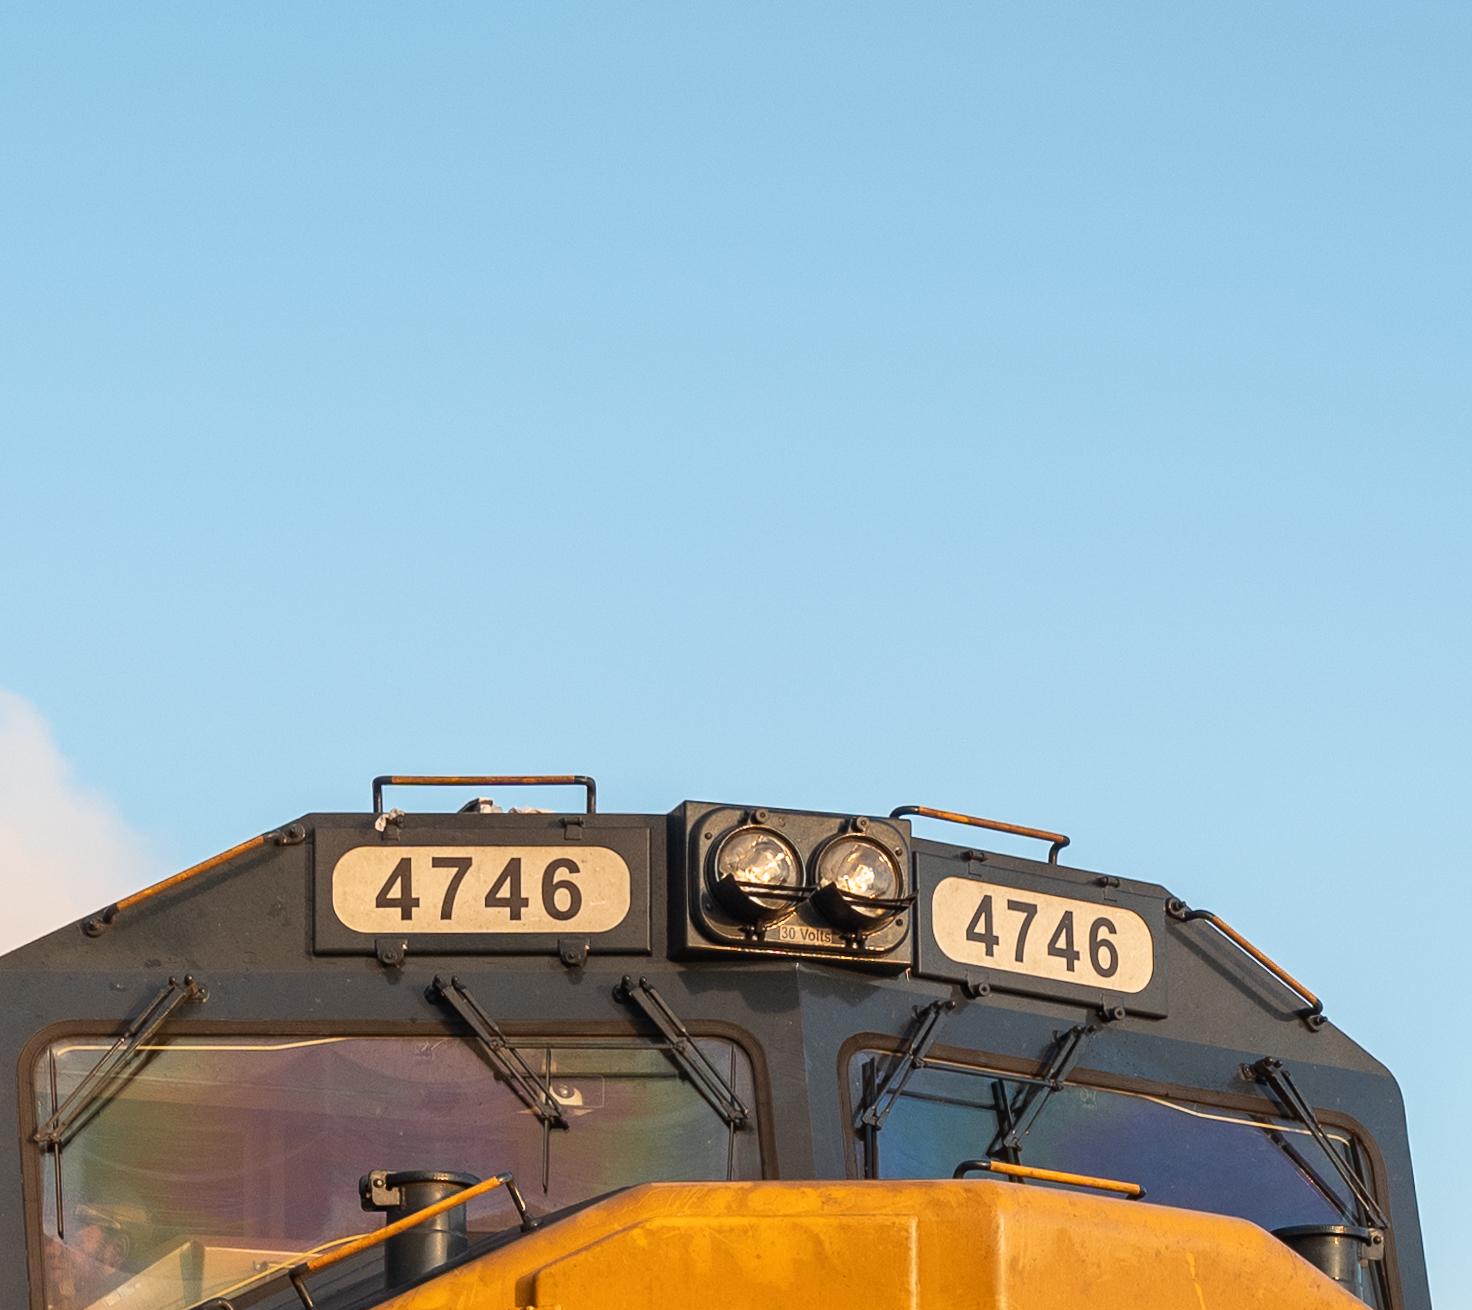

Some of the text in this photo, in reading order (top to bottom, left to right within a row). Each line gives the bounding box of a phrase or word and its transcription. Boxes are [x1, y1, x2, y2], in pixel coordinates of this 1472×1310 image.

[375, 856, 583, 921] 4746
[781, 926, 831, 943] 30 Volts
[965, 893, 1120, 979] 4746
